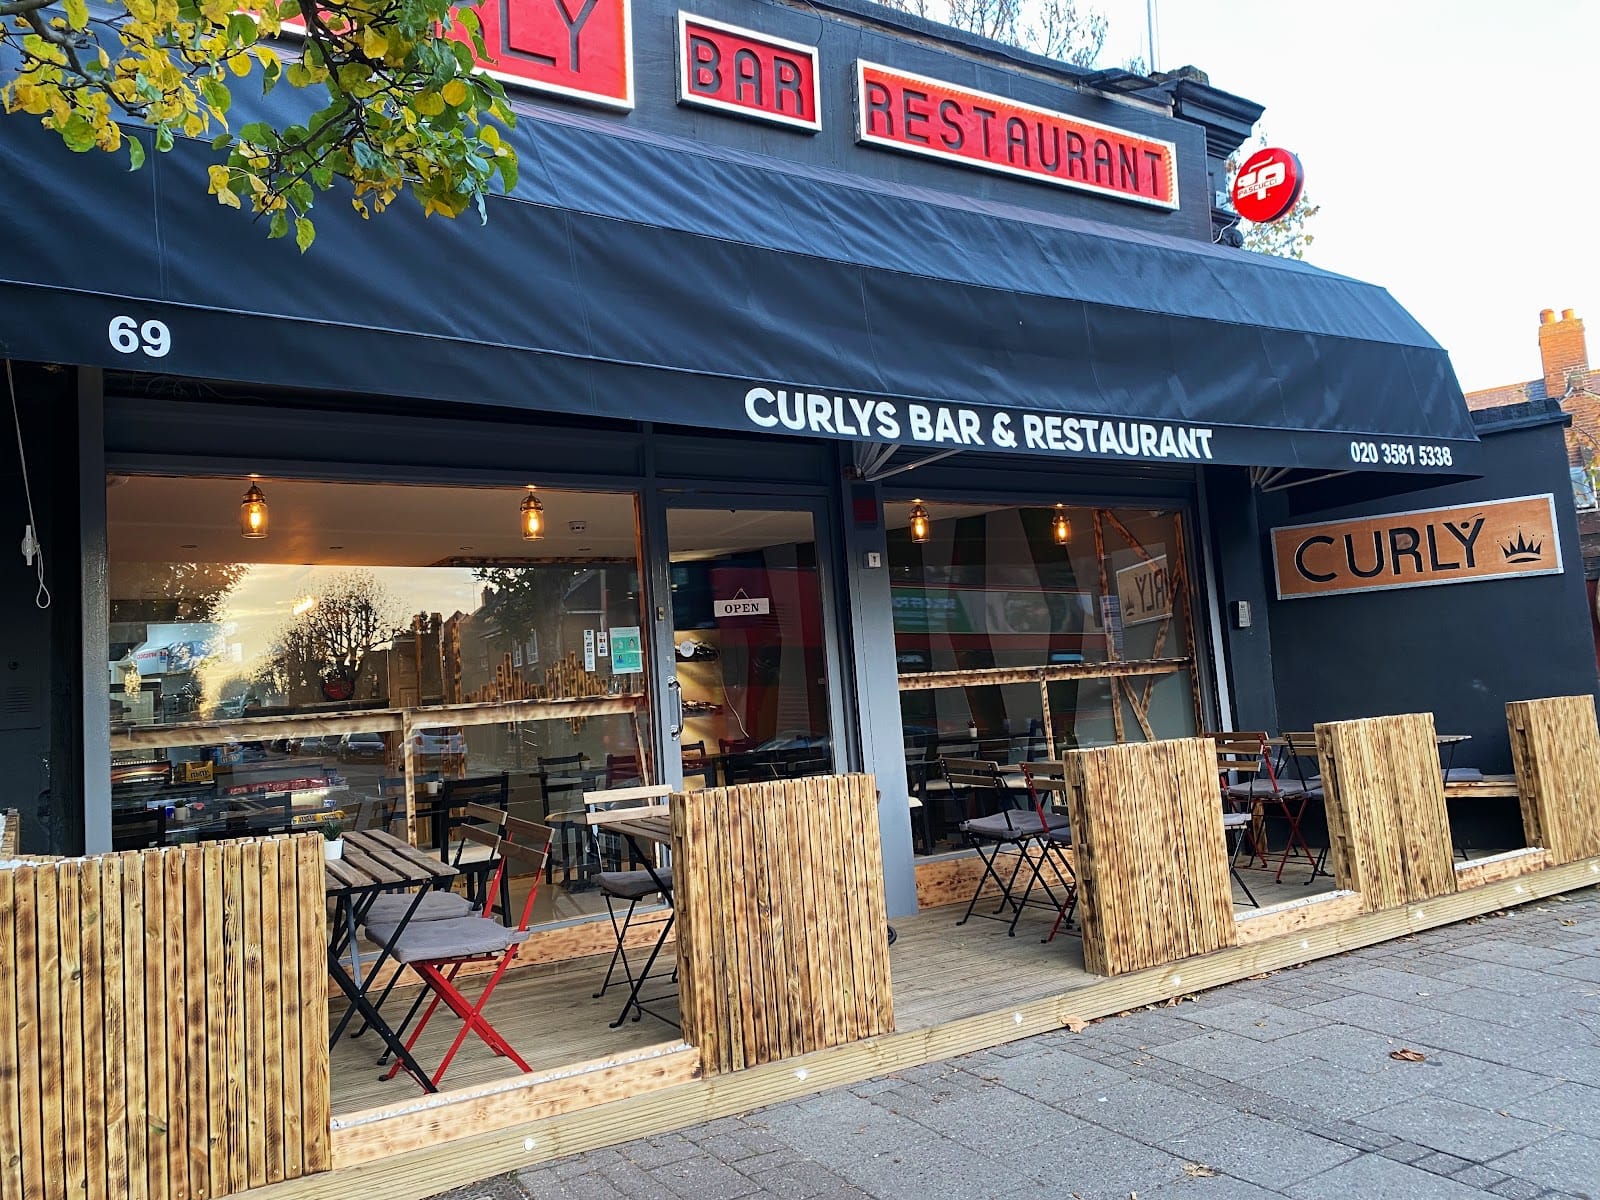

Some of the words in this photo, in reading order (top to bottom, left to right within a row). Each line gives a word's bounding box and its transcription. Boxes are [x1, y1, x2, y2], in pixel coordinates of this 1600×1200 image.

[690, 33, 804, 116] BAR
[865, 79, 1162, 197] RESTAURANT
[1238, 178, 1278, 197] PASCUCCI
[108, 315, 171, 358] 69
[744, 387, 900, 439] CURLYS
[908, 403, 985, 446] BAR
[991, 412, 1018, 449] &
[1022, 414, 1213, 460] RESTAURANT
[1350, 441, 1379, 464] 020
[1381, 443, 1415, 465] 3581
[1418, 445, 1453, 467] 5338
[1295, 512, 1486, 583] CURLY
[724, 603, 759, 614] OPEN
